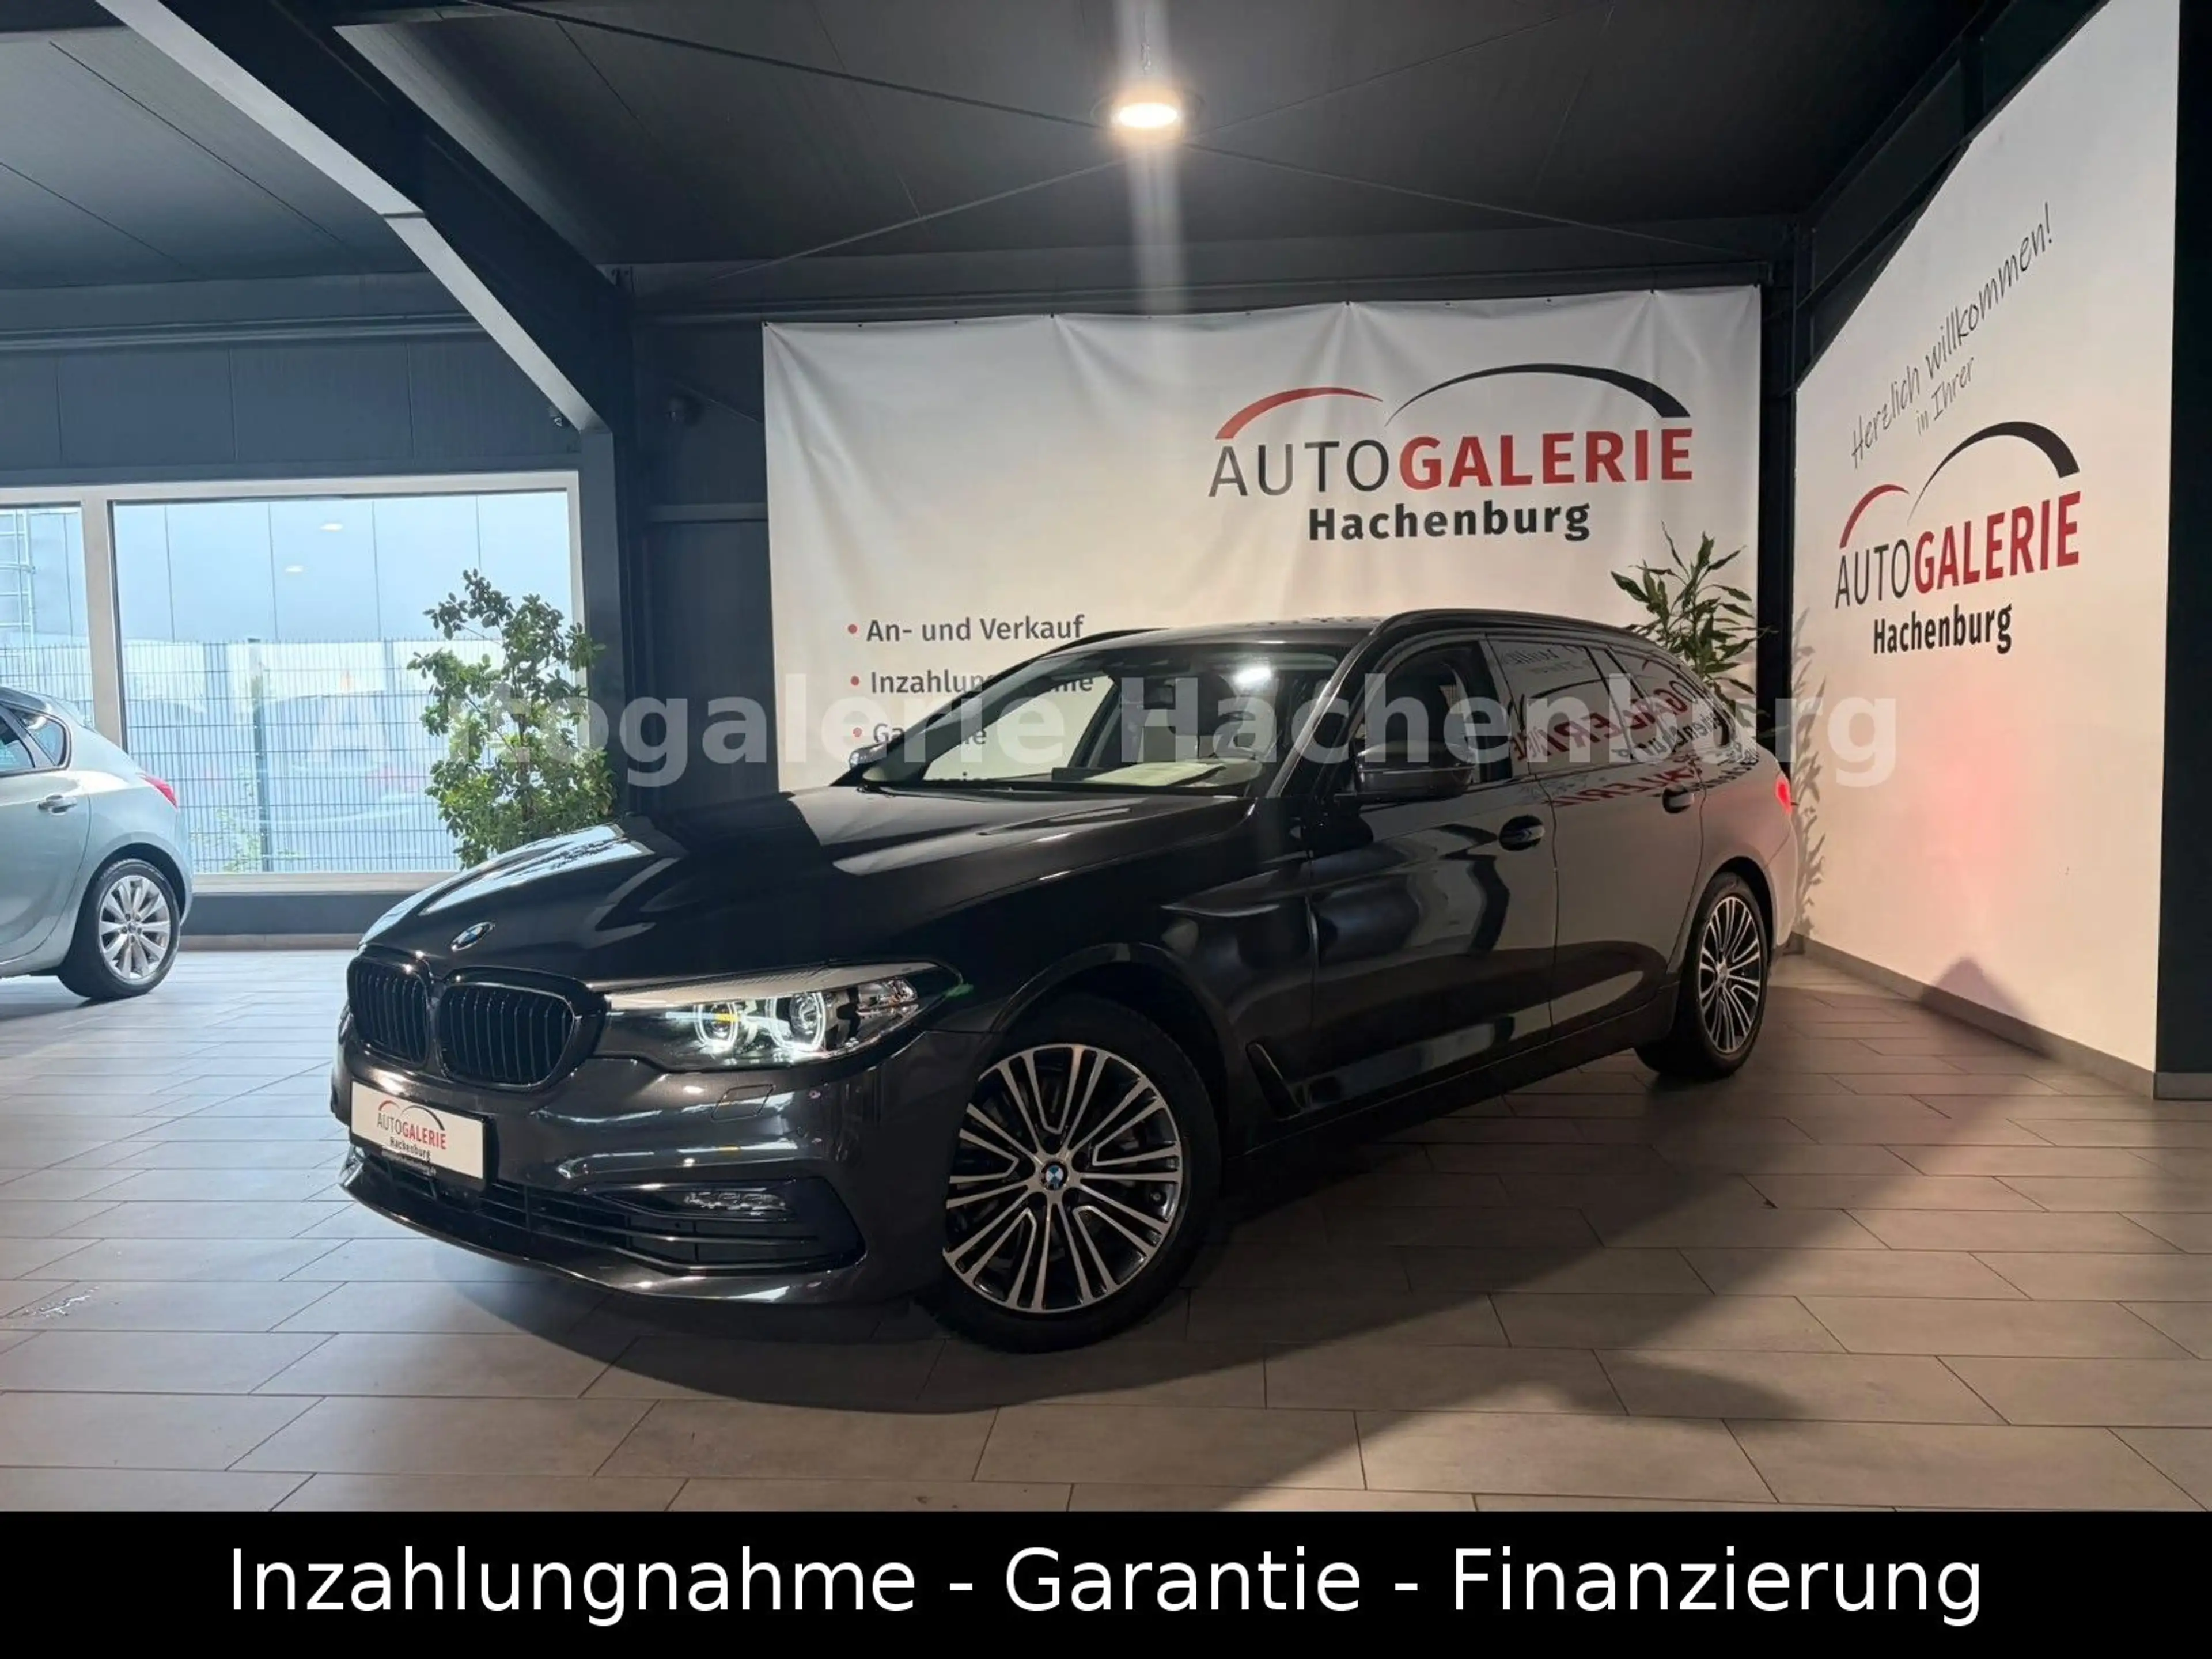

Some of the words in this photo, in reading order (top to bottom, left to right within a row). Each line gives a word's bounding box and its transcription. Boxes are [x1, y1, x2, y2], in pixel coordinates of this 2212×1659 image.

[1851, 365, 1920, 469] Herzlich
[1925, 202, 2052, 380] willkommen!
[1916, 410, 1929, 435] in
[1931, 357, 1974, 421] Ihrer
[1208, 427, 1693, 498] AUTOGALERIE
[1309, 499, 1590, 542] Hachenburg
[1835, 491, 2081, 609] AUTOGALERIE
[866, 619, 912, 642] An-
[922, 616, 970, 641] und
[979, 614, 1085, 640] Verkauf
[1873, 603, 2012, 655] Hachenburg
[377, 1112, 447, 1150] AUTOGALERIE
